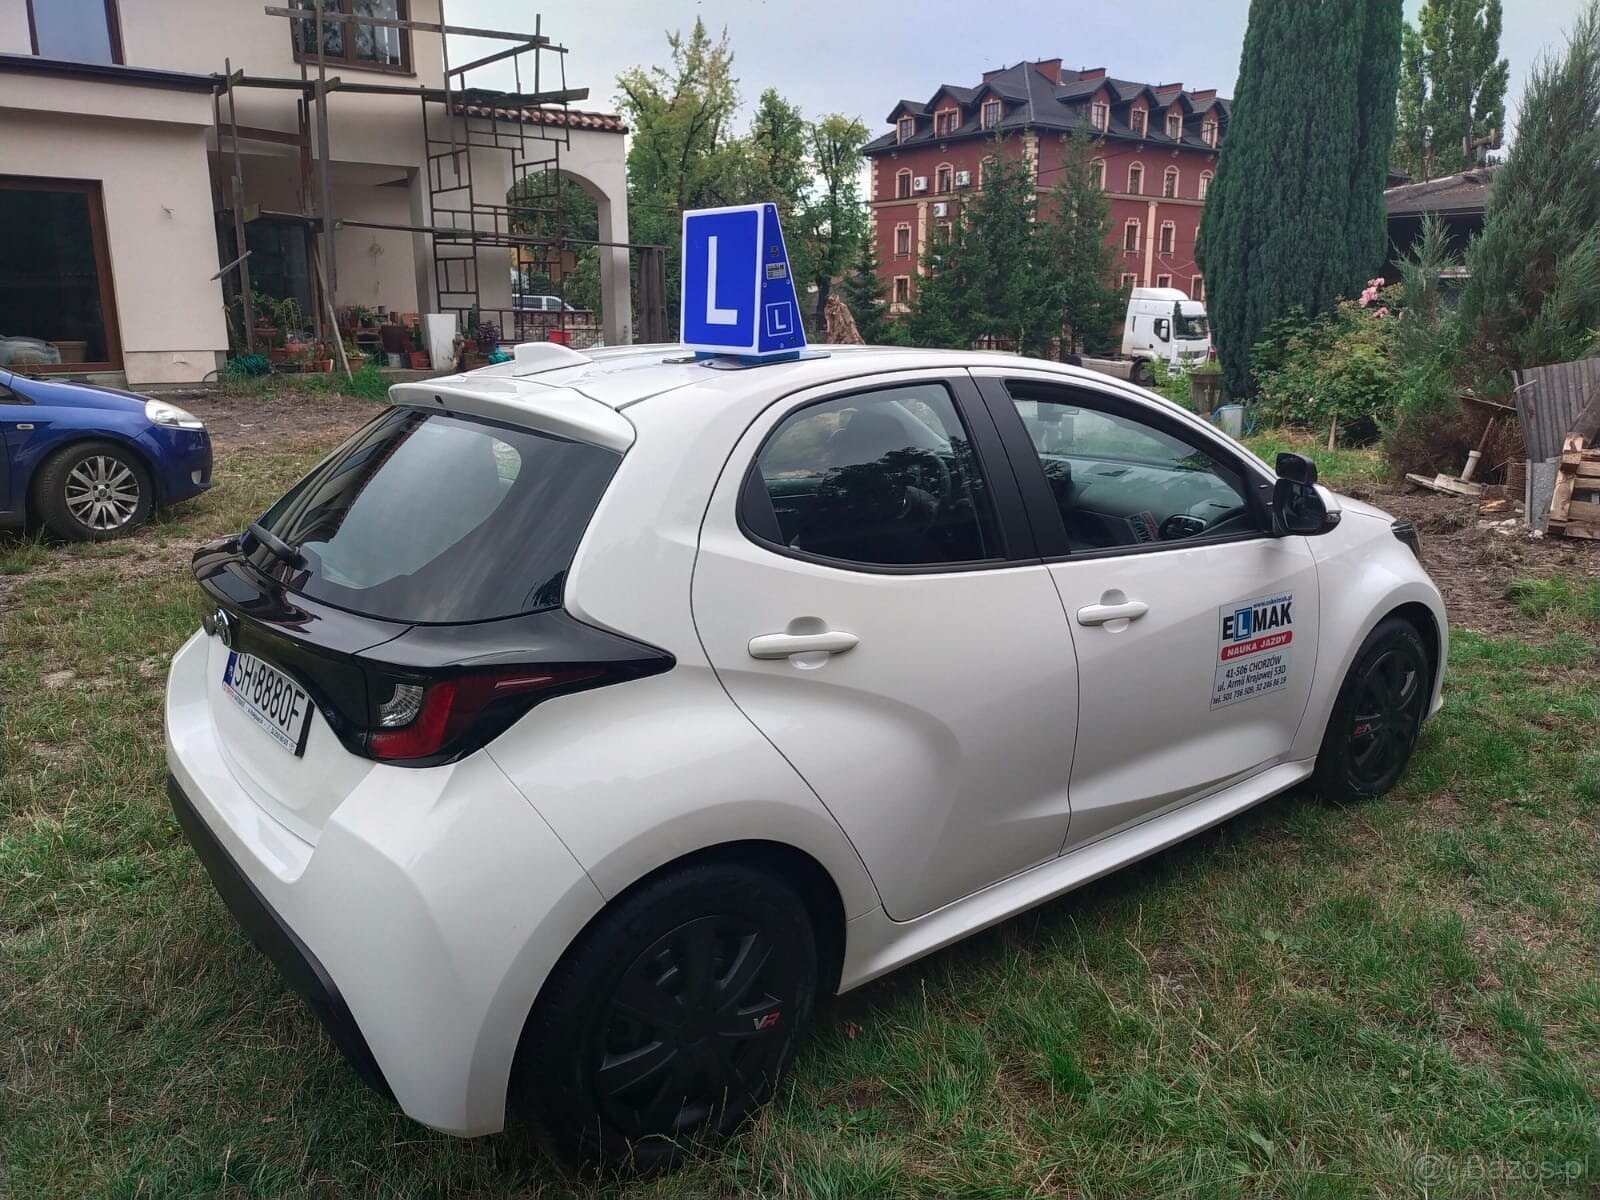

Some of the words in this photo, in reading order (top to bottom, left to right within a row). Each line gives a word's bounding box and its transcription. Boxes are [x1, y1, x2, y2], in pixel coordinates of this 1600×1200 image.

[706, 235, 738, 325] L
[775, 309, 787, 329] L
[1223, 603, 1293, 641] ELMAK
[1227, 643, 1258, 657] NAUKA
[1260, 634, 1287, 648] JAZDY
[1226, 665, 1248, 678] 41-506
[1249, 655, 1282, 672] CHORZÓW
[1227, 676, 1246, 689] Armii
[1246, 668, 1273, 684] Krajowej
